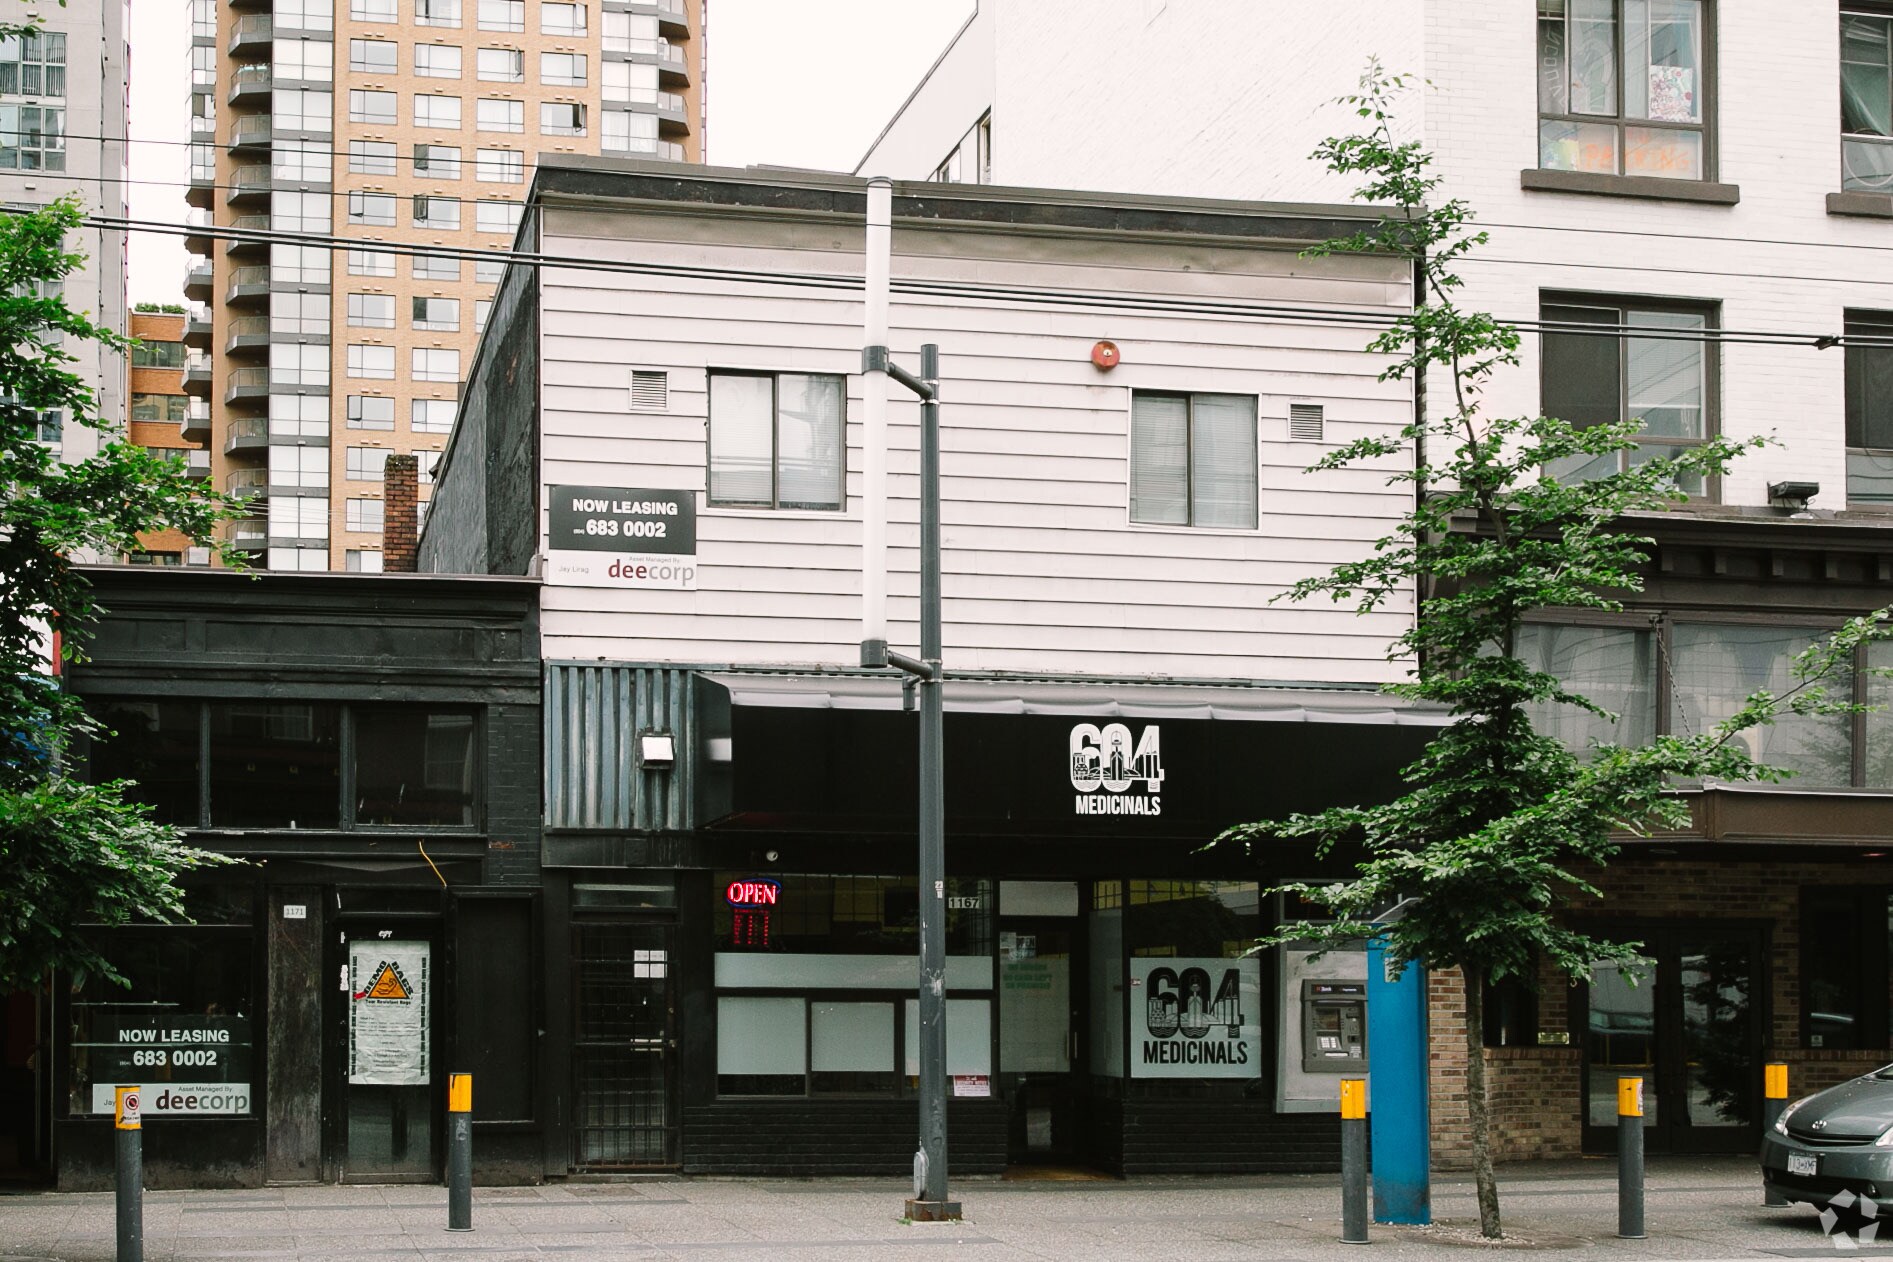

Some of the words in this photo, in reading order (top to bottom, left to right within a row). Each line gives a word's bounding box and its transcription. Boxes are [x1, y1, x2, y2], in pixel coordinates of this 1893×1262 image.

[572, 499, 609, 513] NOW
[612, 500, 678, 516] LEASING
[586, 519, 619, 536] 683
[623, 520, 667, 538] 0002
[558, 566, 570, 574] Jay
[608, 558, 694, 587] deecorp
[1070, 722, 1165, 792] 604
[1075, 794, 1161, 816] MEDICINALS
[728, 881, 776, 905] OPEN
[949, 897, 979, 908] 1167
[285, 907, 305, 916] 1171
[363, 960, 387, 994] DEMO
[391, 961, 414, 995] BAGS
[1146, 966, 1245, 1039] 604
[119, 1029, 157, 1043] NOW
[161, 1029, 230, 1043] LEASING
[133, 1050, 167, 1066] 683
[172, 1050, 217, 1066] 0002
[1143, 1040, 1248, 1065] MEDICINALS
[195, 1085, 223, 1094] Managed
[155, 1089, 248, 1114] deecorp
